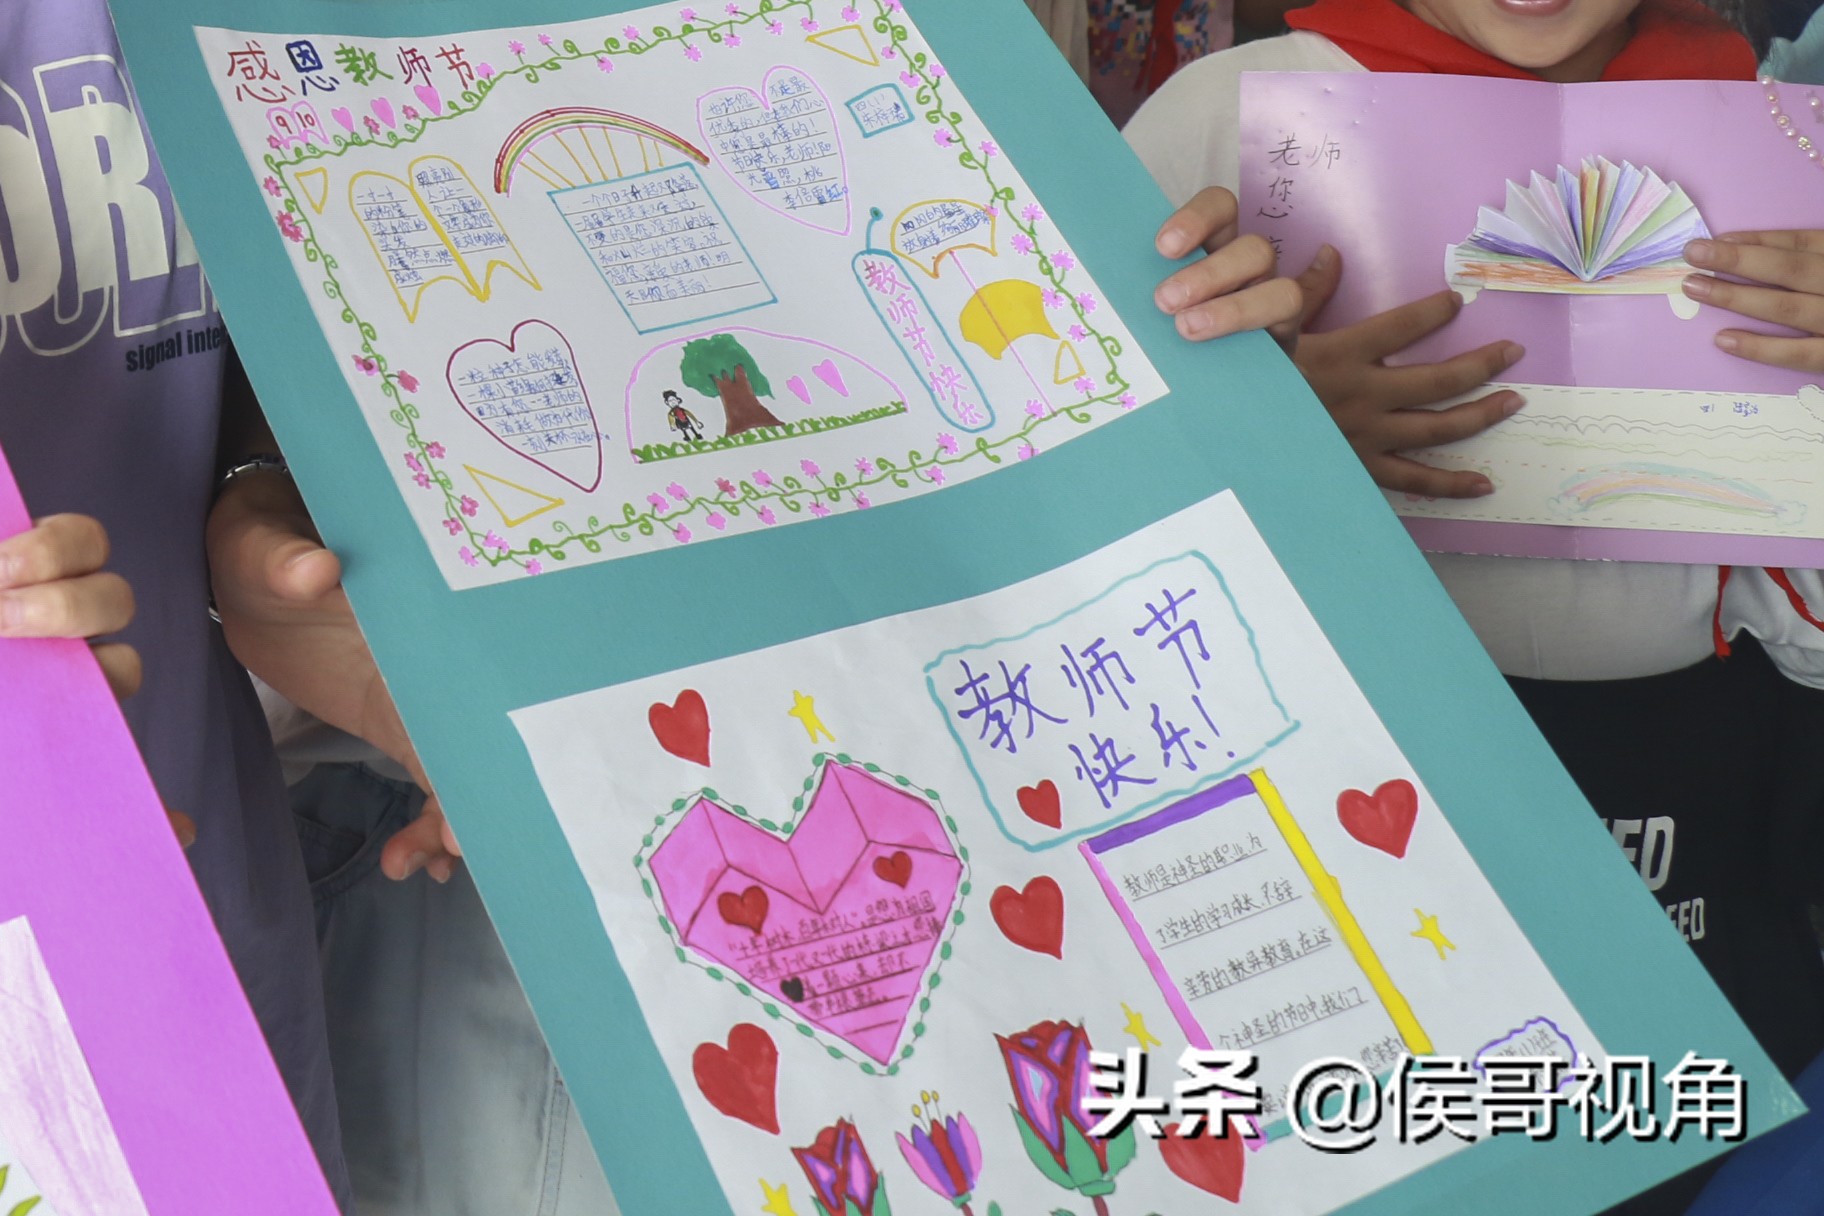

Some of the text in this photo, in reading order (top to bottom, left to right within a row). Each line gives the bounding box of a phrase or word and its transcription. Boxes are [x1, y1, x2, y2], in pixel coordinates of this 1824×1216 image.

[227, 40, 475, 104] 感恩教师节
[1267, 133, 1341, 170] 老师
[955, 588, 1210, 754] 教师节
[1068, 693, 1235, 809] 快乐！
[1600, 815, 1675, 892] ED
